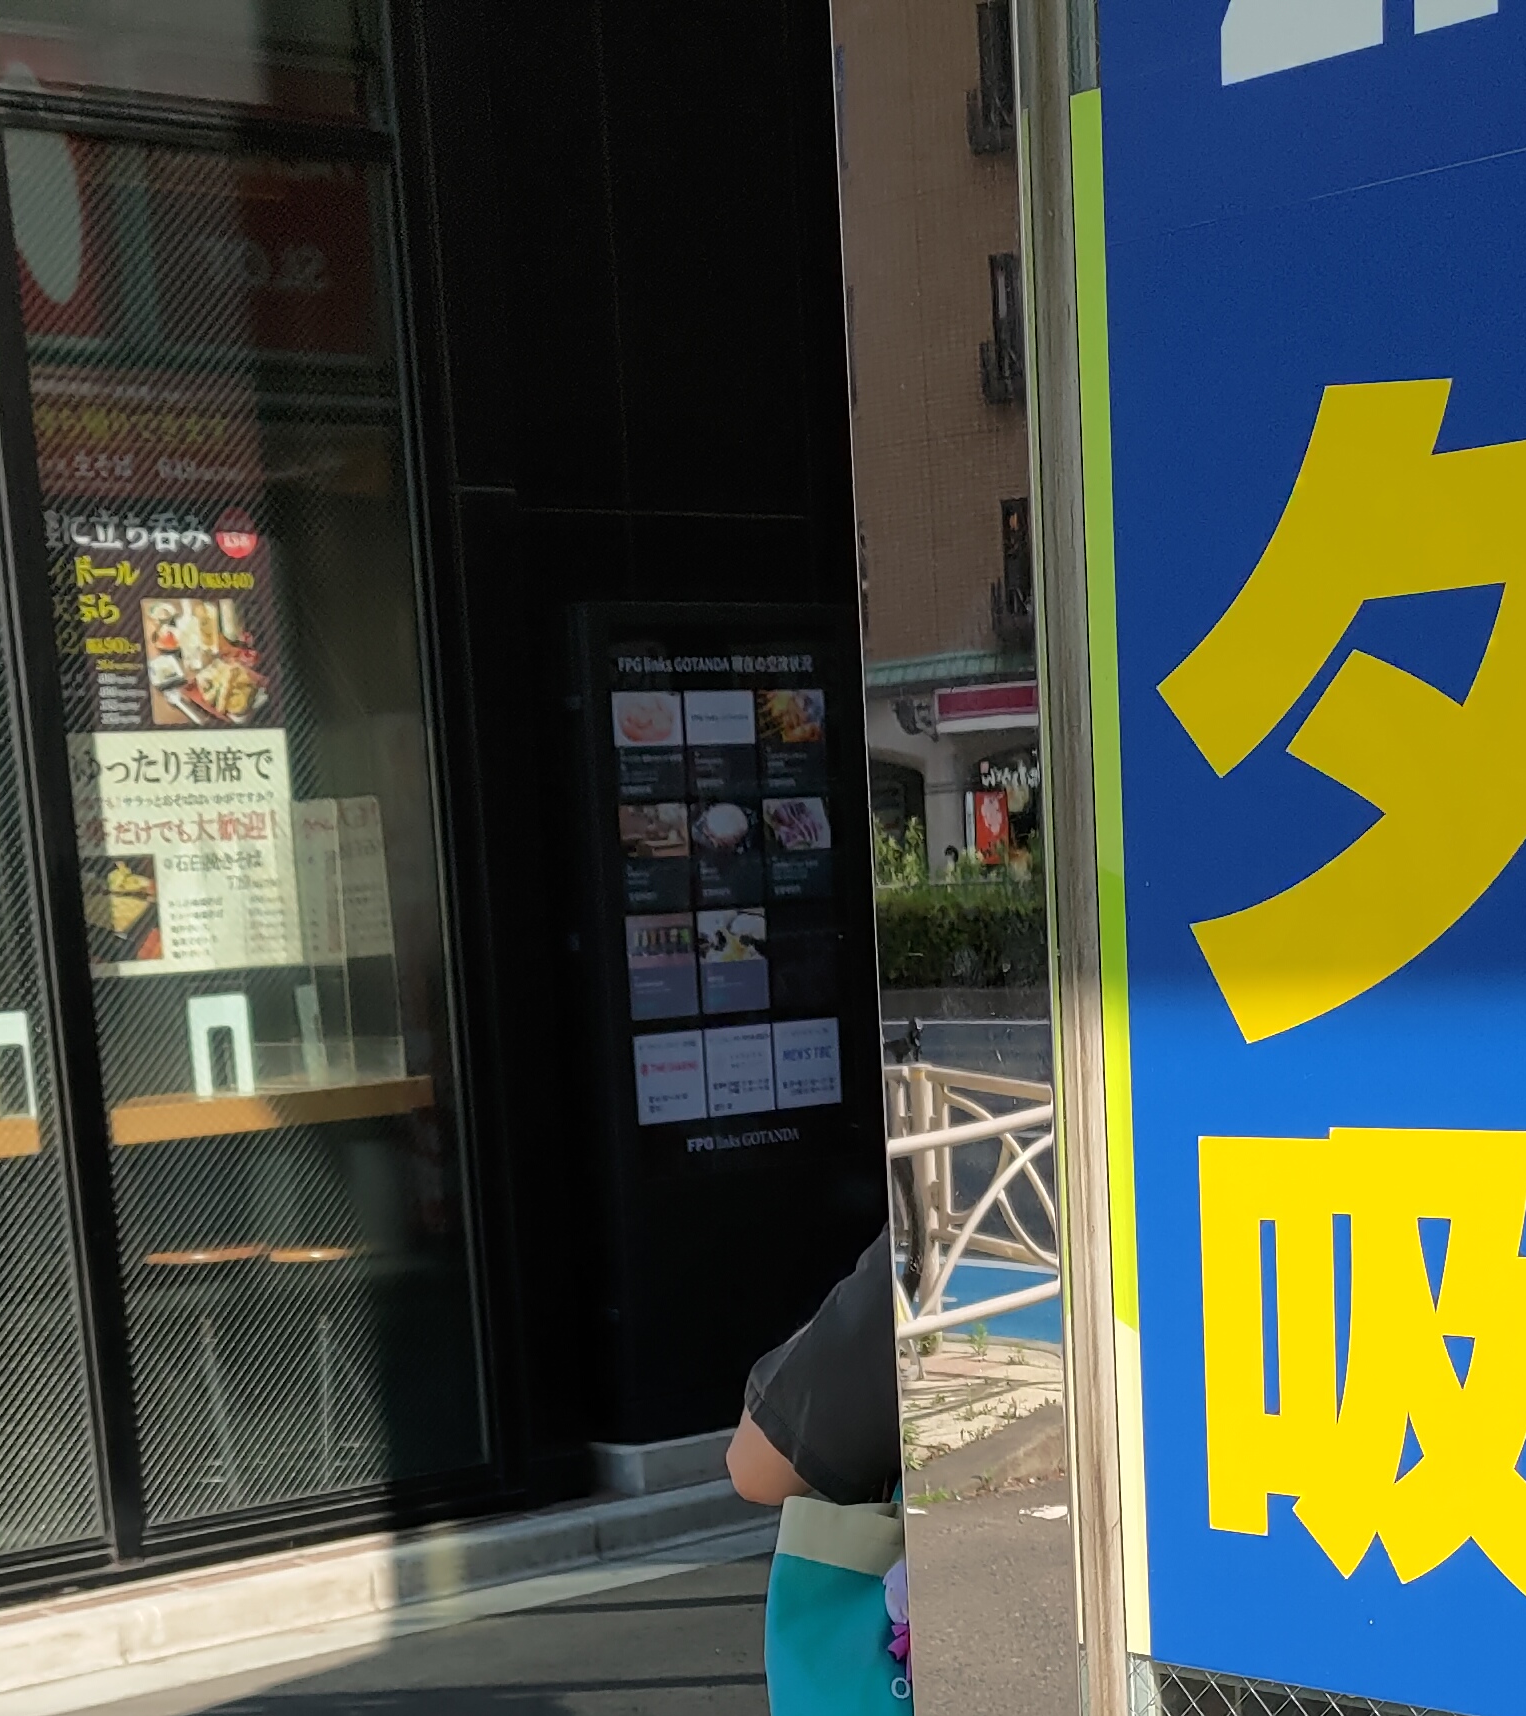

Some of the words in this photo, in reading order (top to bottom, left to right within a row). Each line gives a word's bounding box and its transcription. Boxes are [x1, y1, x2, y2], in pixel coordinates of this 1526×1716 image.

[156, 562, 198, 589] 310
[618, 657, 641, 672] FPG
[675, 656, 729, 672] GOTANDA
[686, 1137, 714, 1152] FPG
[742, 1127, 800, 1147] GOTANDA
